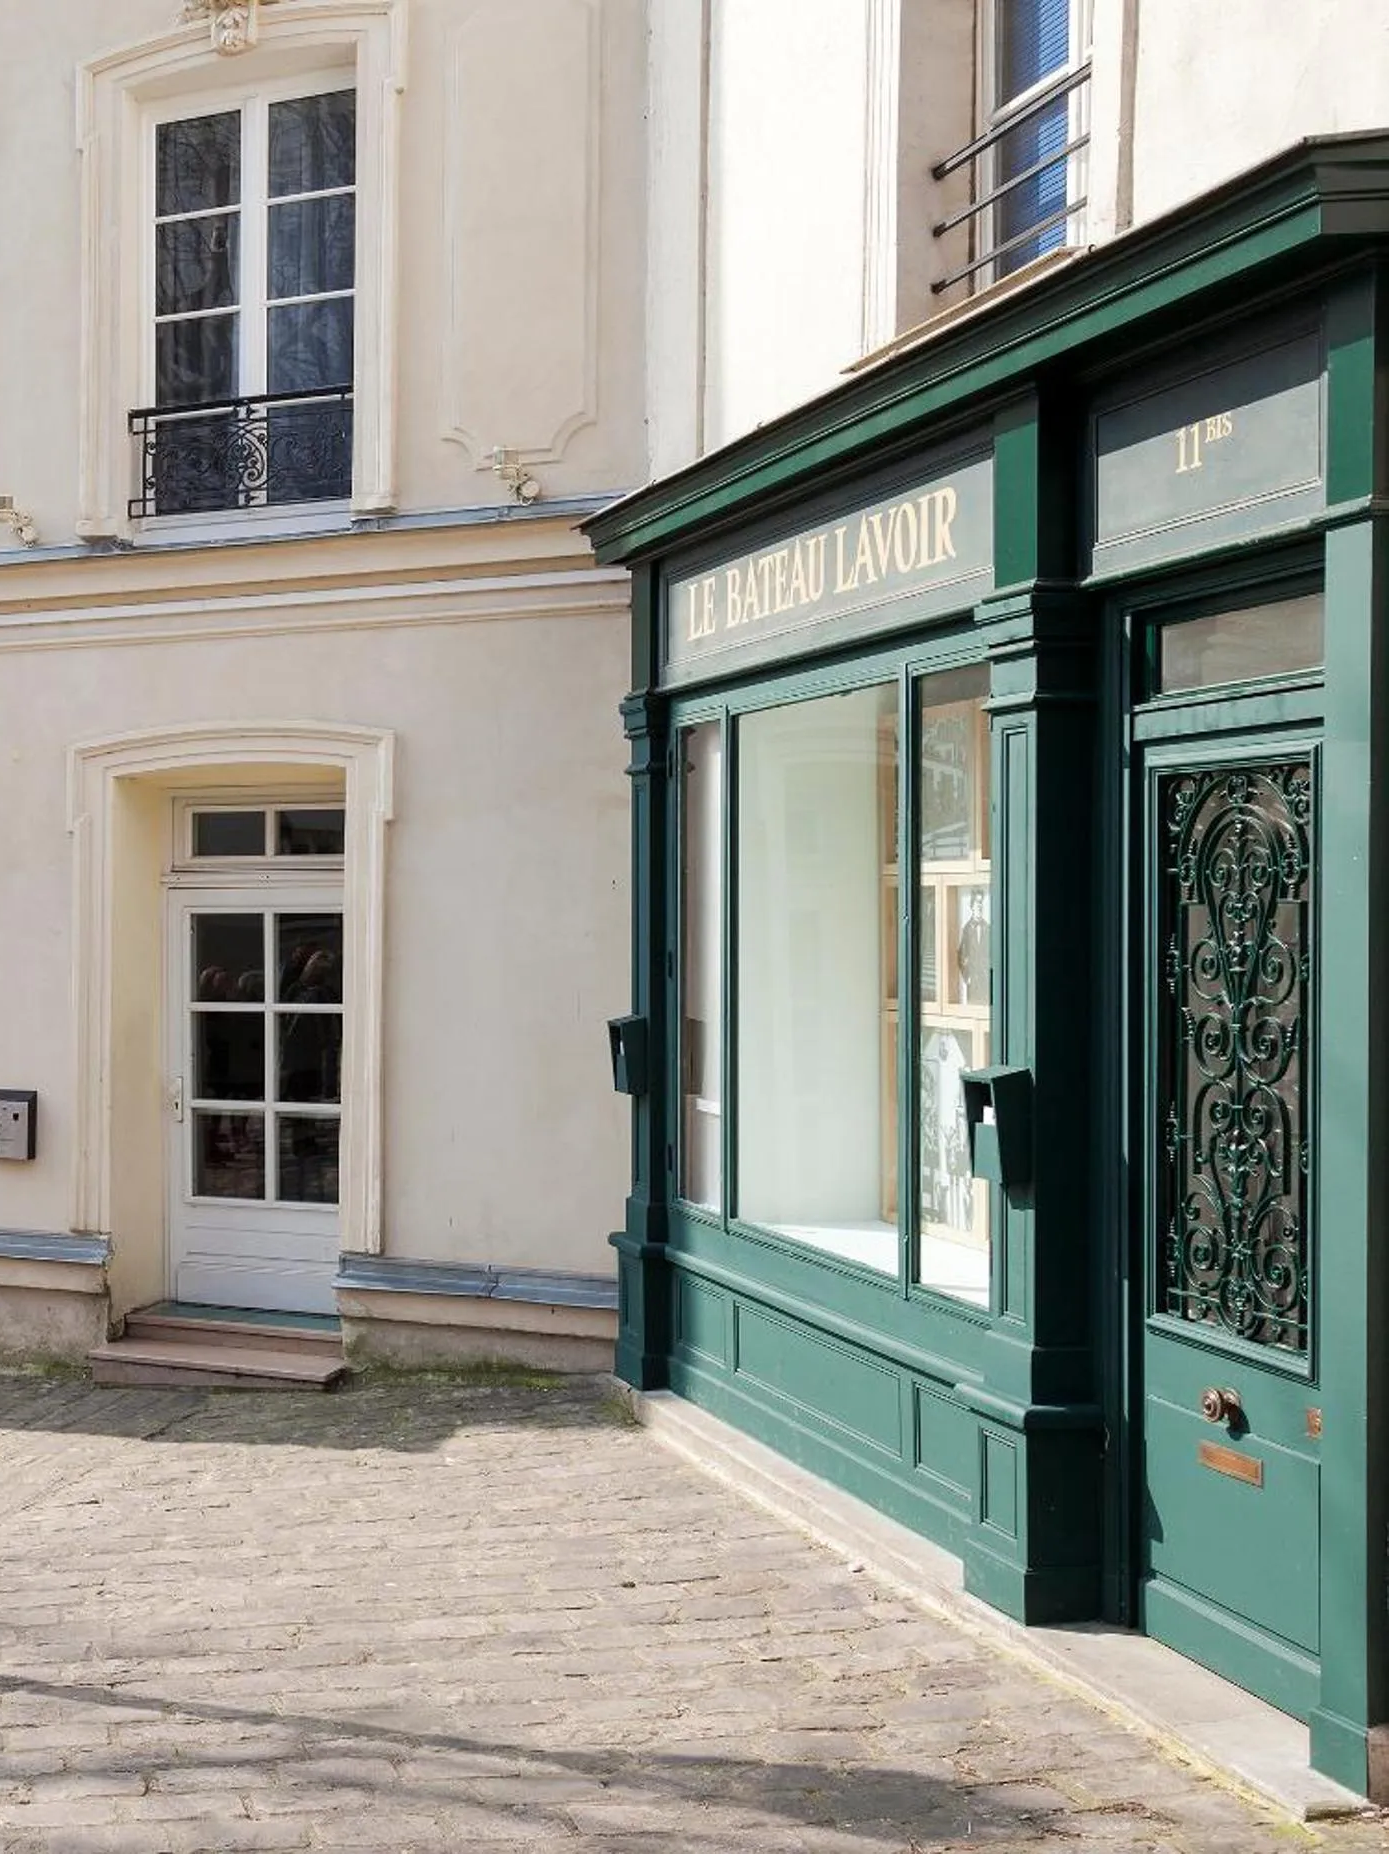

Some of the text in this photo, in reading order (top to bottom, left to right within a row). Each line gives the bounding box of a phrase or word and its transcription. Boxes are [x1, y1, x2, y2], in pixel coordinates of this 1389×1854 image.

[1176, 424, 1203, 473] 11
[687, 486, 957, 641] LE BATEAU LAVOIR
